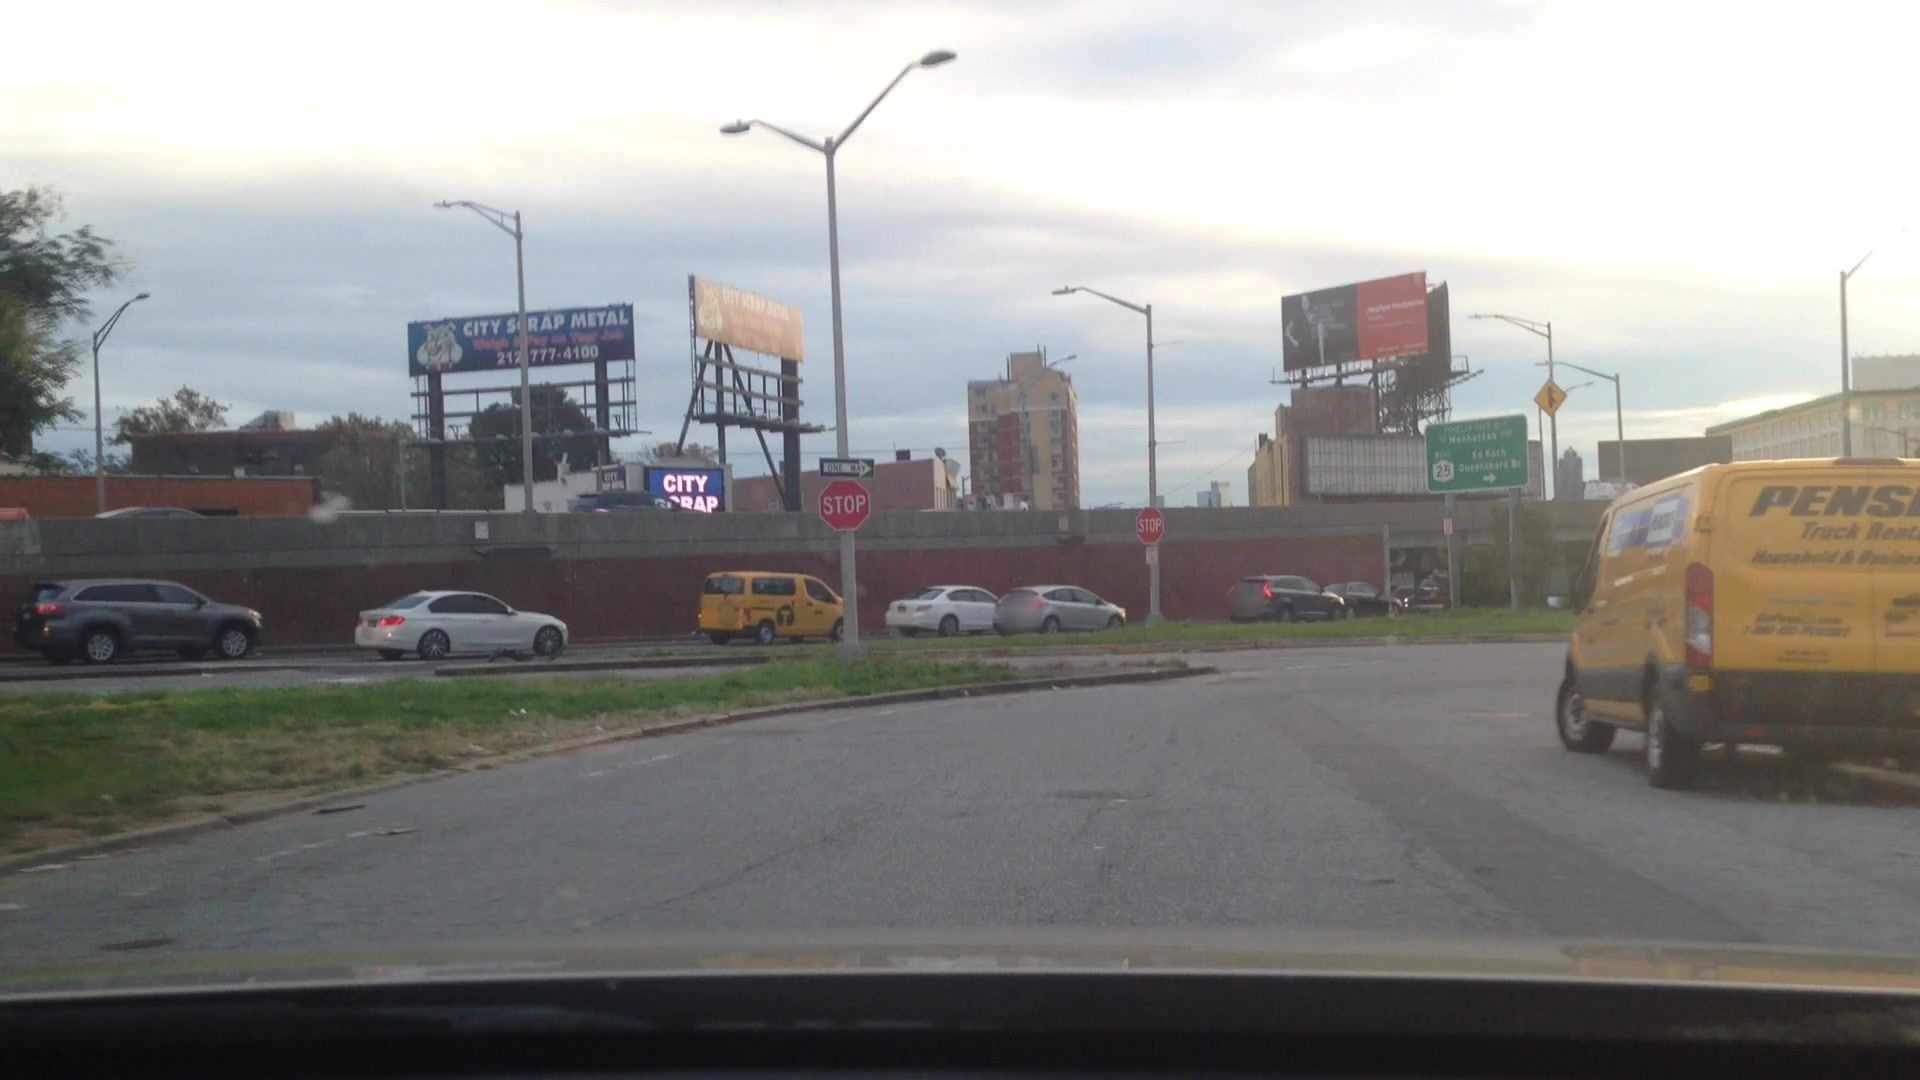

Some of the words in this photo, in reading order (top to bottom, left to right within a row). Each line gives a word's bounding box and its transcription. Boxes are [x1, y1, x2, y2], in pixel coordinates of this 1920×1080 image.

[463, 319, 501, 337] CITY
[571, 309, 629, 329] METAL
[497, 345, 599, 366] 212777-4100
[827, 463, 842, 473] ONE
[849, 463, 866, 473] WAY
[1436, 463, 1452, 478] 25
[663, 474, 708, 493] CITY
[823, 494, 867, 515] STOP
[1138, 518, 1162, 533] STOP
[1801, 521, 1861, 540] Truck
